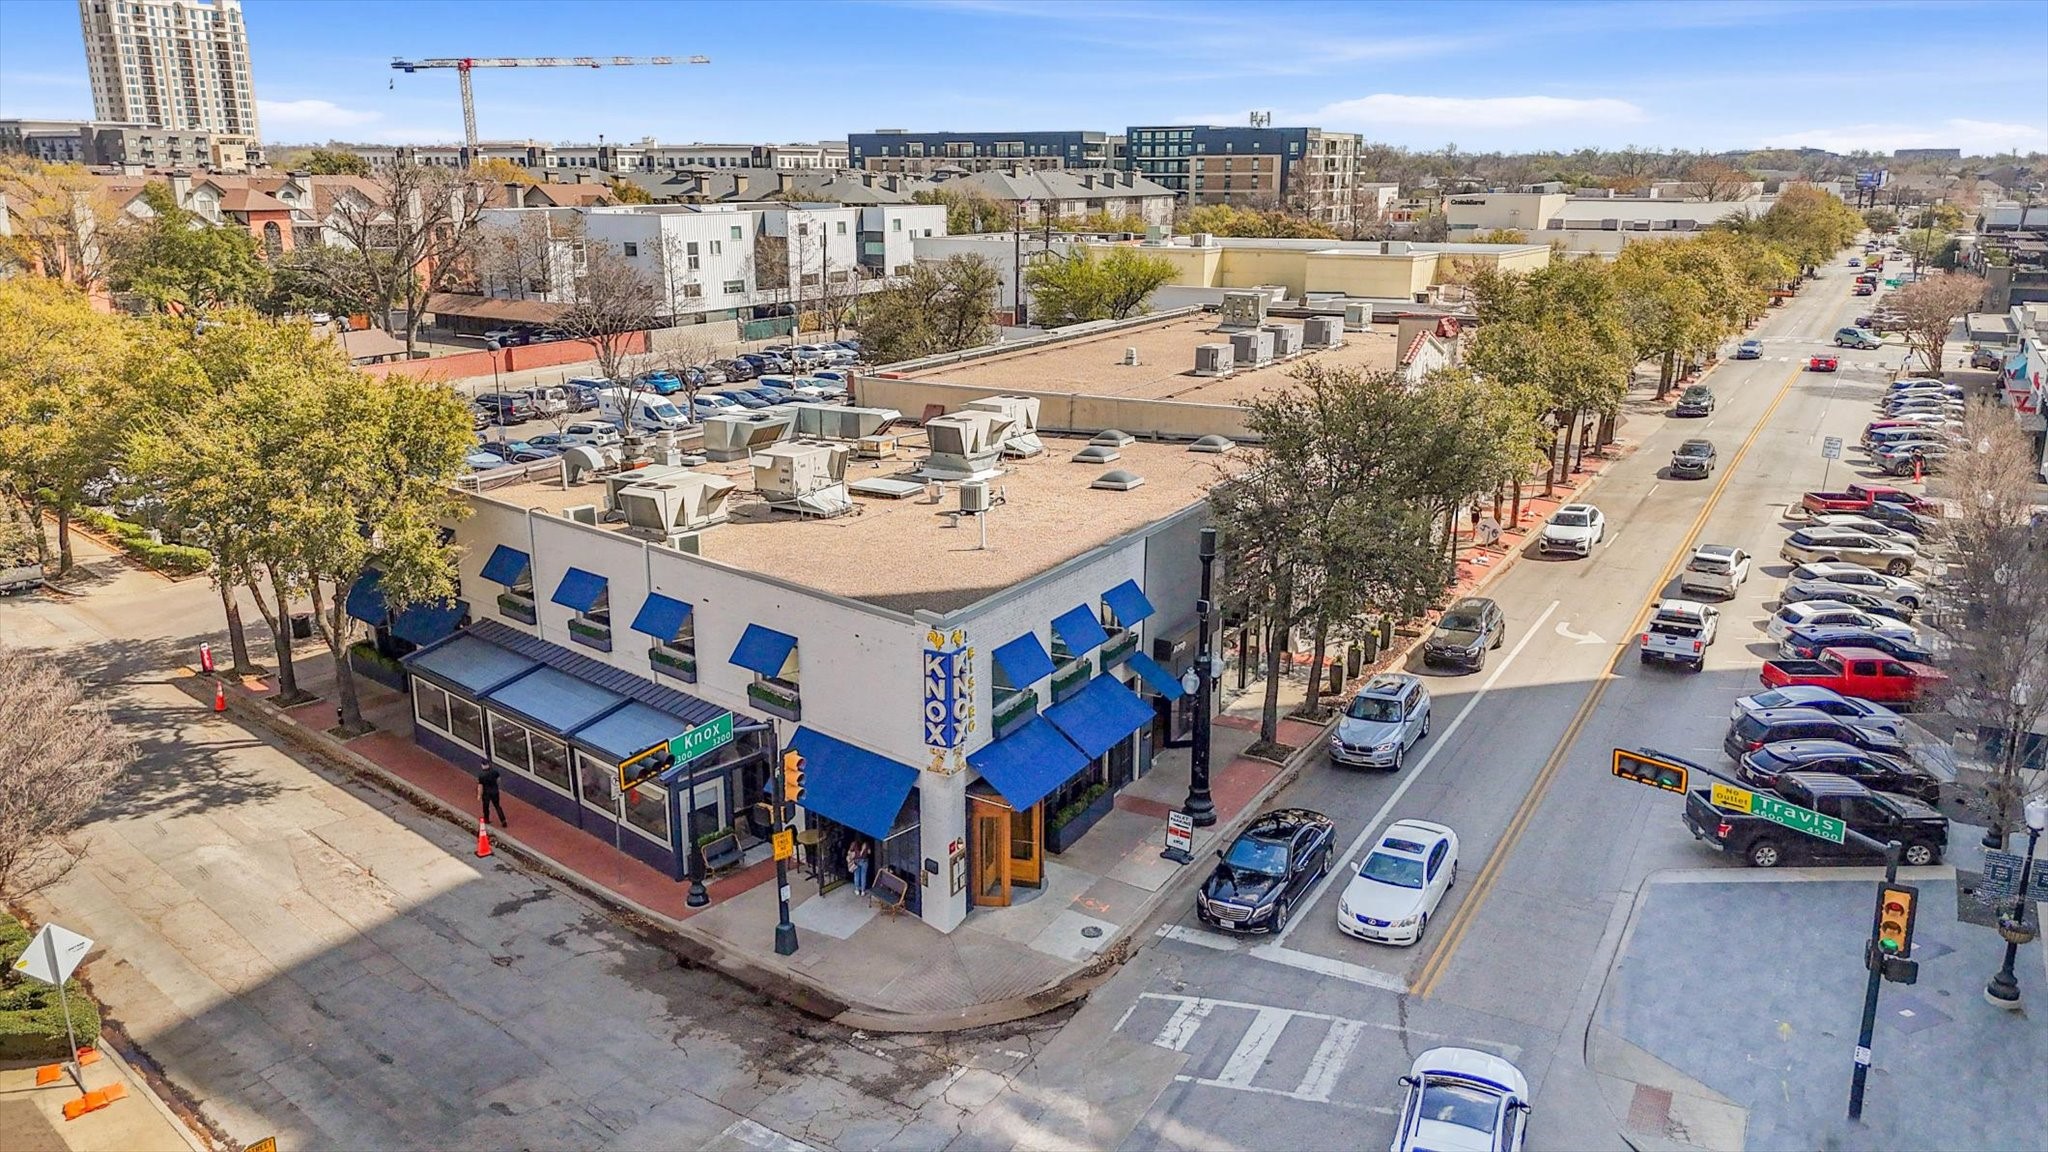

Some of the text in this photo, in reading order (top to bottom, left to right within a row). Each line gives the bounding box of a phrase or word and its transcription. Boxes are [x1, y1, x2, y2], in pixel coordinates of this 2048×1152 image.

[967, 646, 976, 733] BISTRO
[925, 653, 947, 746] KNOX
[684, 723, 720, 750] Knox
[712, 731, 731, 746] 3200
[1716, 793, 1748, 805] Outlet
[1726, 788, 1739, 796] No
[1753, 809, 1784, 823] 4600
[1759, 797, 1833, 831] Travis
[1807, 826, 1839, 840] 4500
